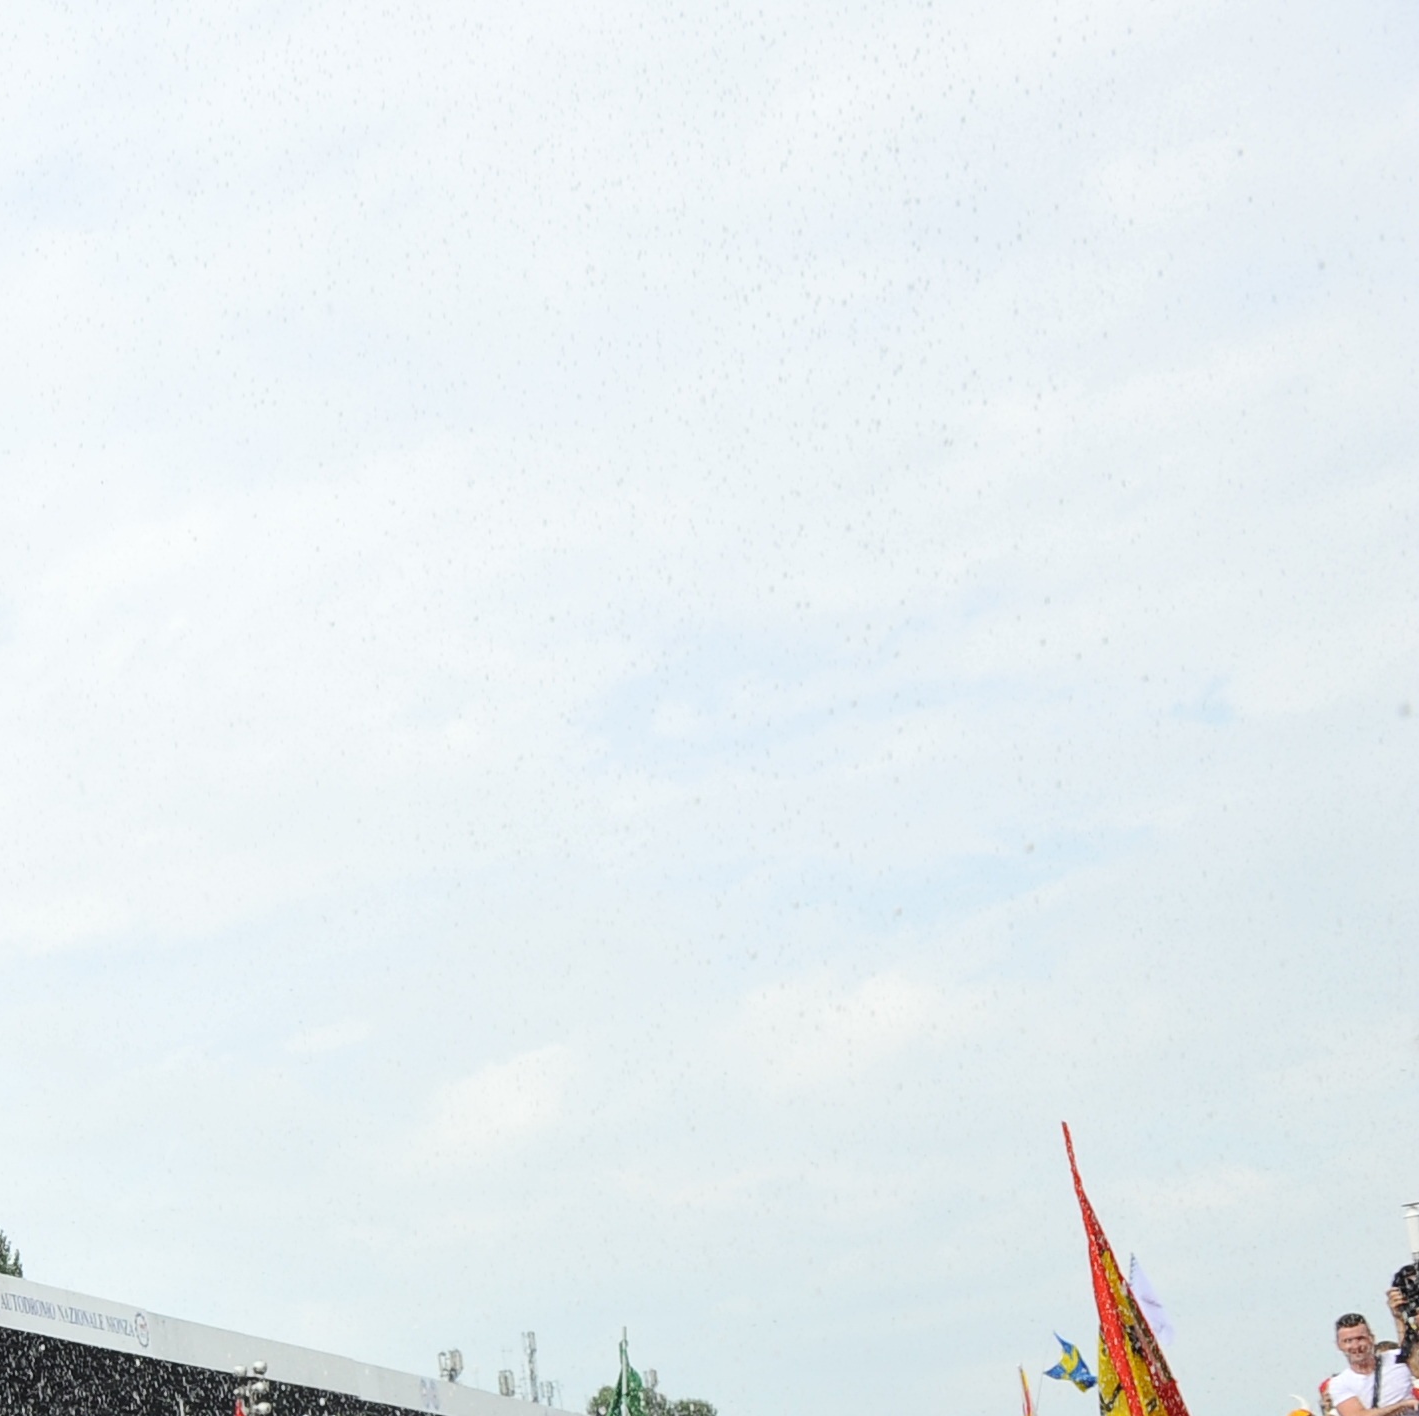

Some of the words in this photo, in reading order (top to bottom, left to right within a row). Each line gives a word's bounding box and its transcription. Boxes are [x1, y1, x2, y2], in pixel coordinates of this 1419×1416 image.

[0, 1293, 56, 1319] AUTODROMO
[58, 1305, 104, 1330] NAZIONALE
[106, 1316, 135, 1337] MONZA
